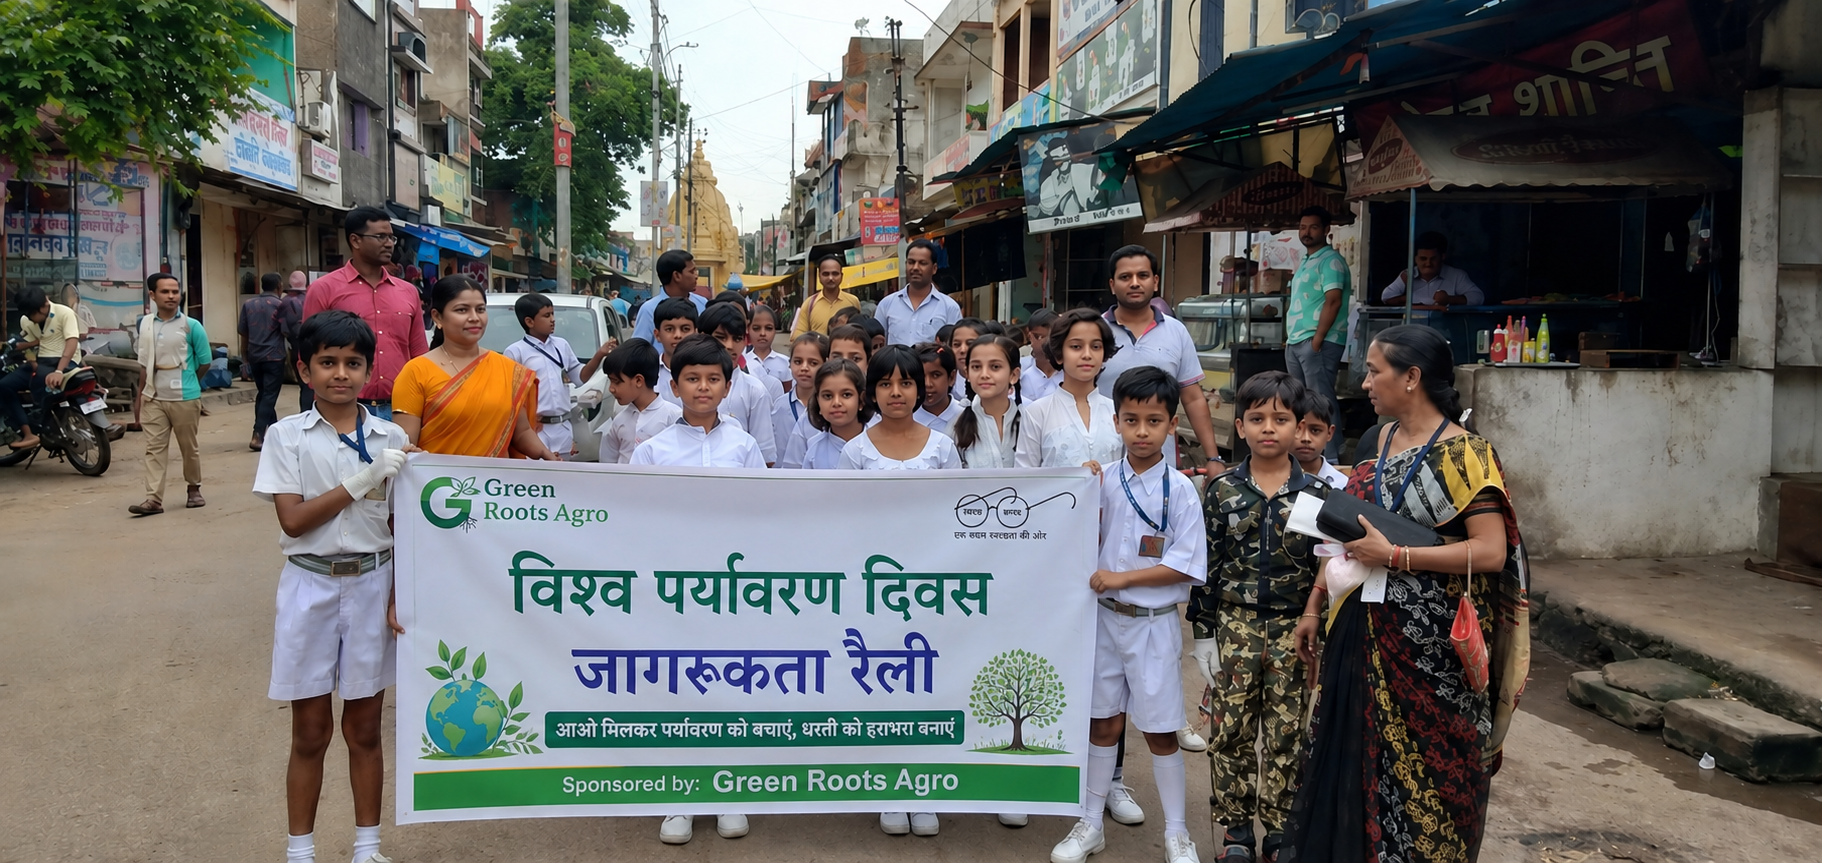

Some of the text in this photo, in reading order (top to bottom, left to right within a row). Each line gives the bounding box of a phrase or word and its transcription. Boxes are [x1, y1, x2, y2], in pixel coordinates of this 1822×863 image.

[485, 478, 555, 498] Green
[484, 502, 608, 527] Roots Agro
[508, 550, 994, 622] विश्व पर्यावरण दिवस
[571, 628, 939, 695] जागरूकता रैली
[556, 717, 956, 740] आओ मिलकर पर्यावरण को बचाएं, धरती को हराभरा बनाएं
[562, 768, 959, 797] Sponsored by: Green Roots Agro
